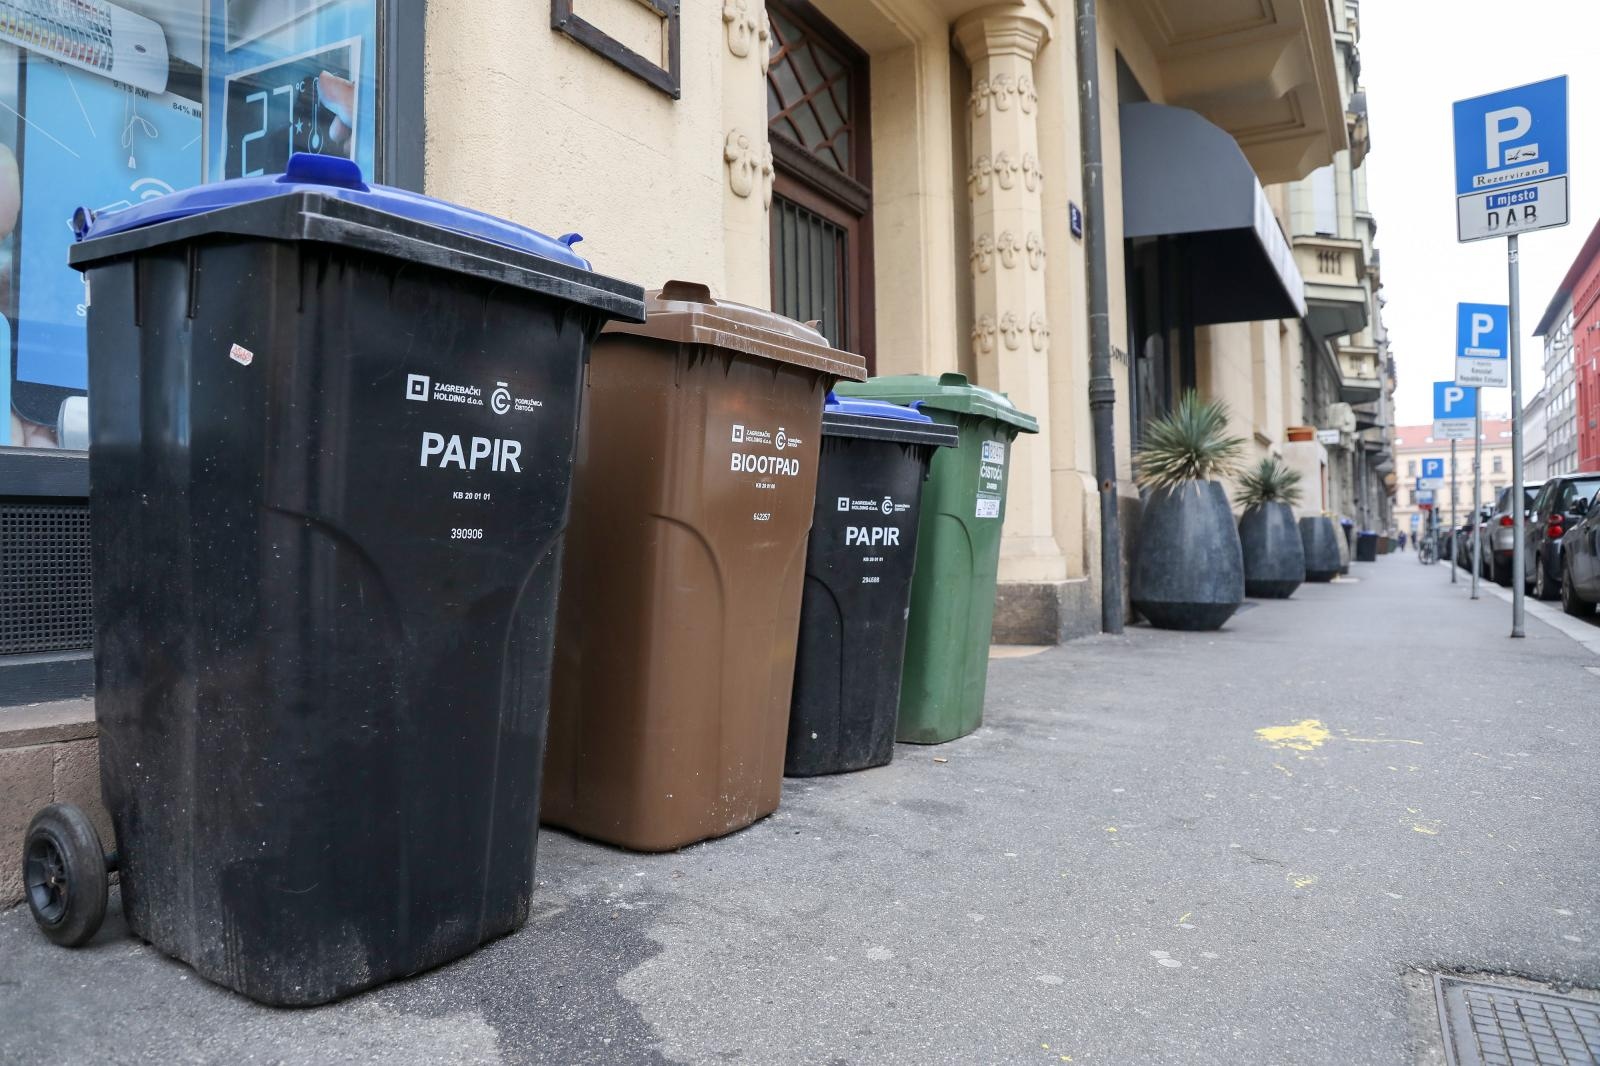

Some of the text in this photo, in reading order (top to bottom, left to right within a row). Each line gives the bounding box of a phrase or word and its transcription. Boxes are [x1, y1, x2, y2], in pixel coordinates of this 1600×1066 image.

[172, 102, 190, 114] 84%
[1484, 106, 1532, 170] P
[1477, 168, 1544, 186] Rezervirano
[1488, 190, 1536, 208] 1 mjesto
[1472, 313, 1494, 347] P
[434, 382, 481, 396] ZAGREBAČKI
[434, 392, 484, 406] HOLDING d.o.o.
[1444, 387, 1464, 412] P
[420, 432, 522, 472] PAPIR
[731, 452, 800, 476] BIOOTPAD
[1426, 461, 1438, 476] P
[465, 492, 473, 500] 20
[450, 528, 483, 539] 390906
[846, 526, 900, 546] PAPIR
